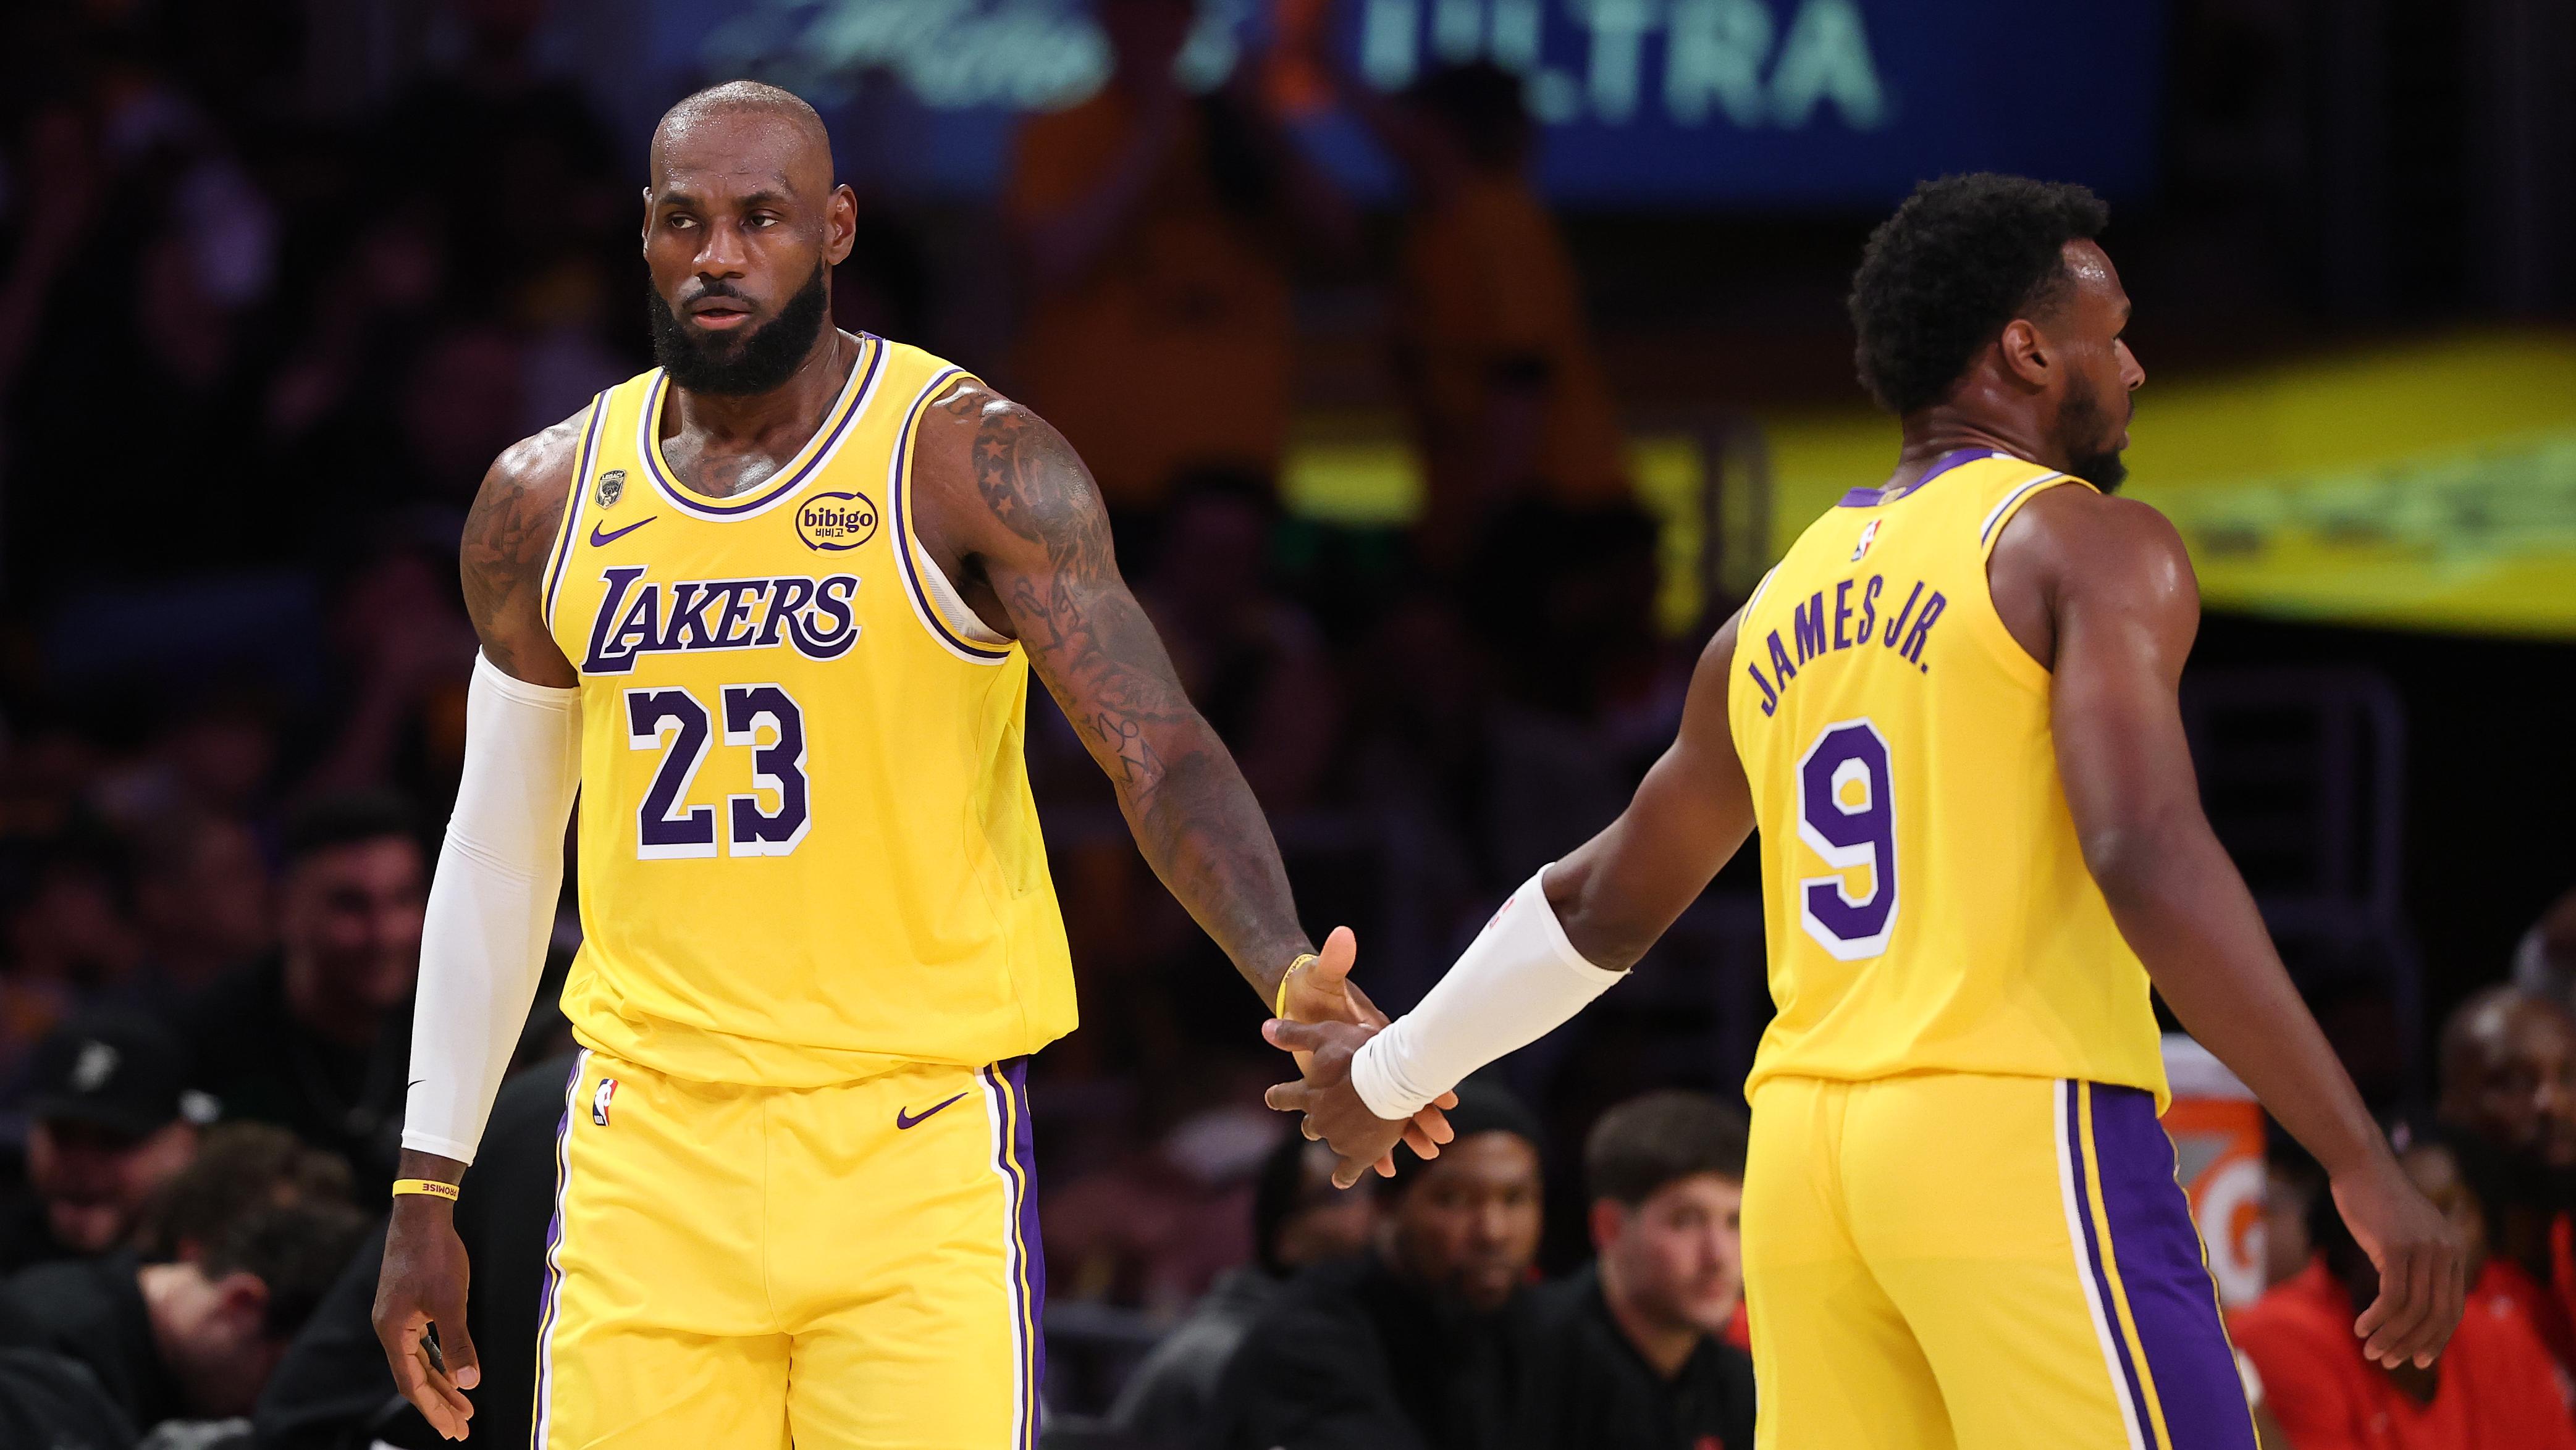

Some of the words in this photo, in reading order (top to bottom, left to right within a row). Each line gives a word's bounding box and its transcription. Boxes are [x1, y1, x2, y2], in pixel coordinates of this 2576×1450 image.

[804, 508, 873, 533] bibigo
[815, 529, 844, 537] 비비고
[579, 564, 862, 676] LAKERS
[1748, 574, 1884, 718] JAMES
[1884, 580, 1947, 674] JR.
[623, 682, 812, 860] 23
[1796, 717, 1900, 961] 9
